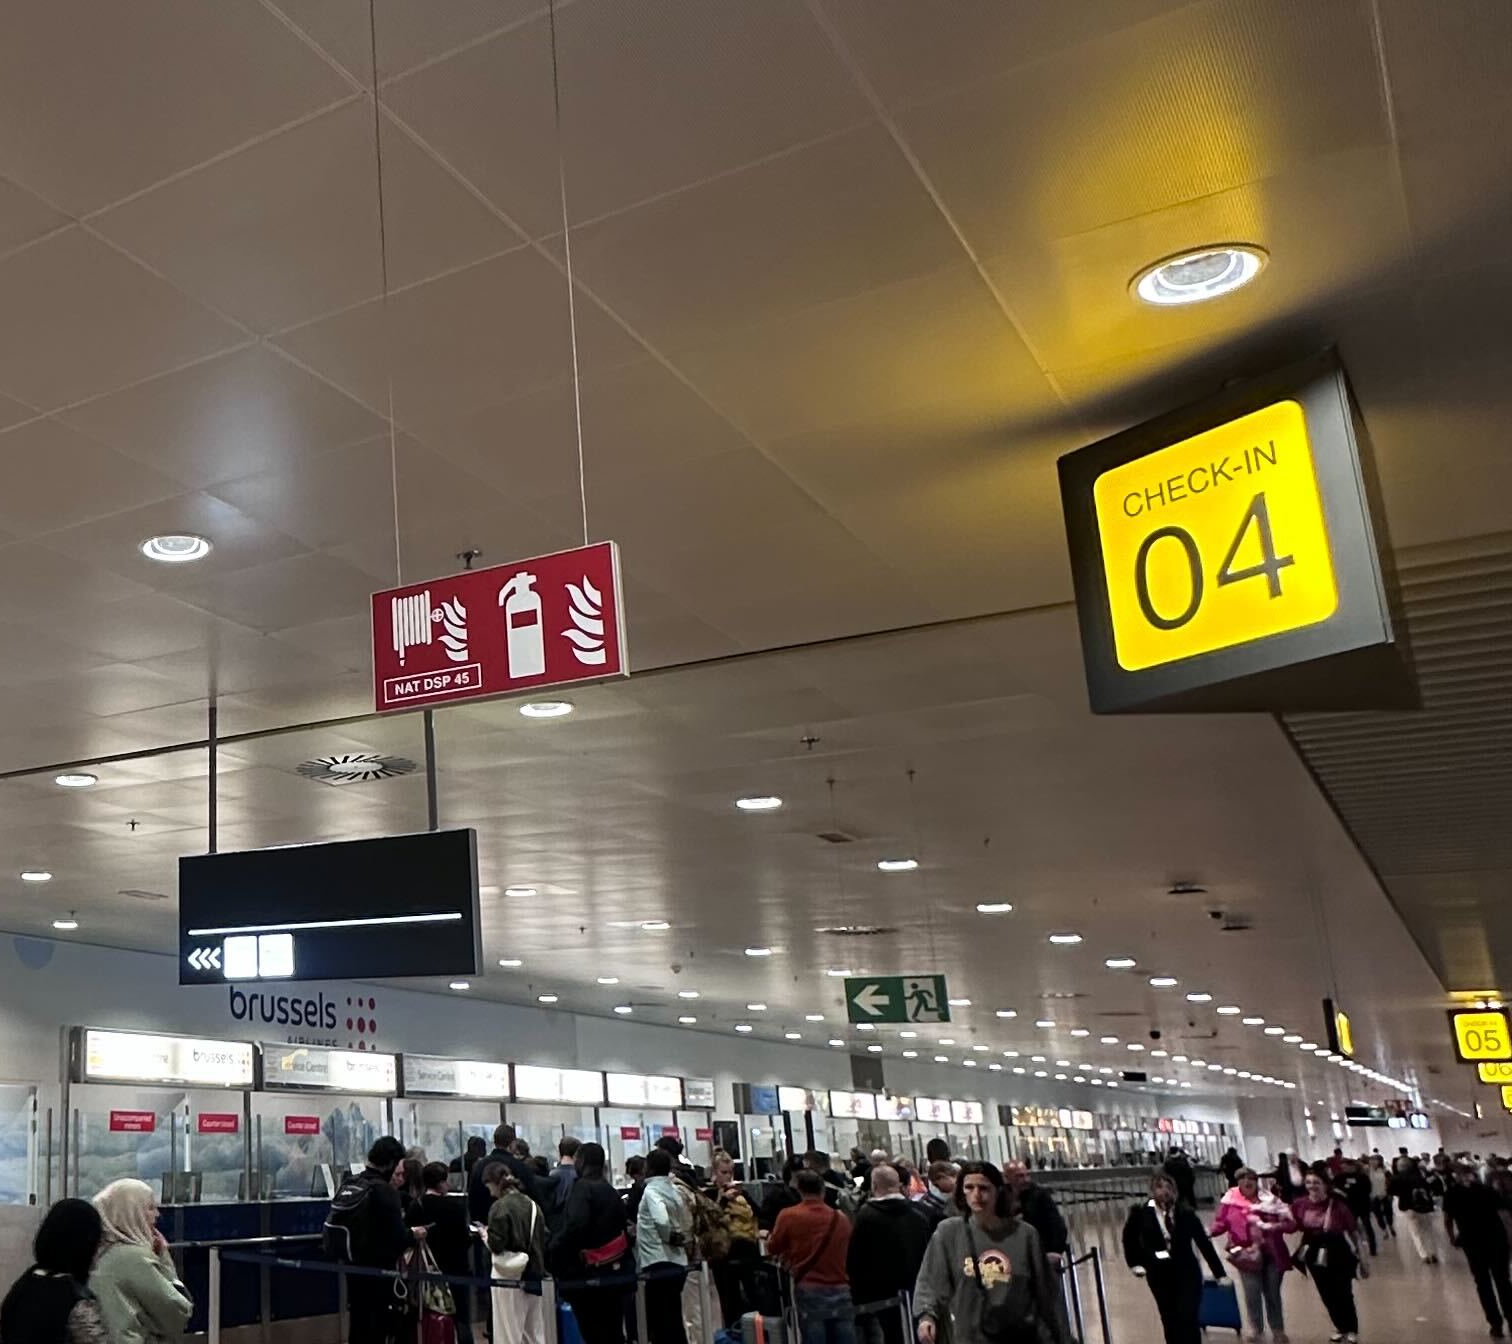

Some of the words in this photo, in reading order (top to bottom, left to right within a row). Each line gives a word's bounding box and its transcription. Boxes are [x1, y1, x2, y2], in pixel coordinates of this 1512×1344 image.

[1123, 440, 1277, 518] CHECK-IN
[1134, 491, 1296, 631] 04
[394, 680, 420, 696] NAT
[424, 675, 451, 691] DSP
[454, 671, 470, 685] 45
[229, 985, 337, 1030] brussels
[1465, 1029, 1501, 1052] 05
